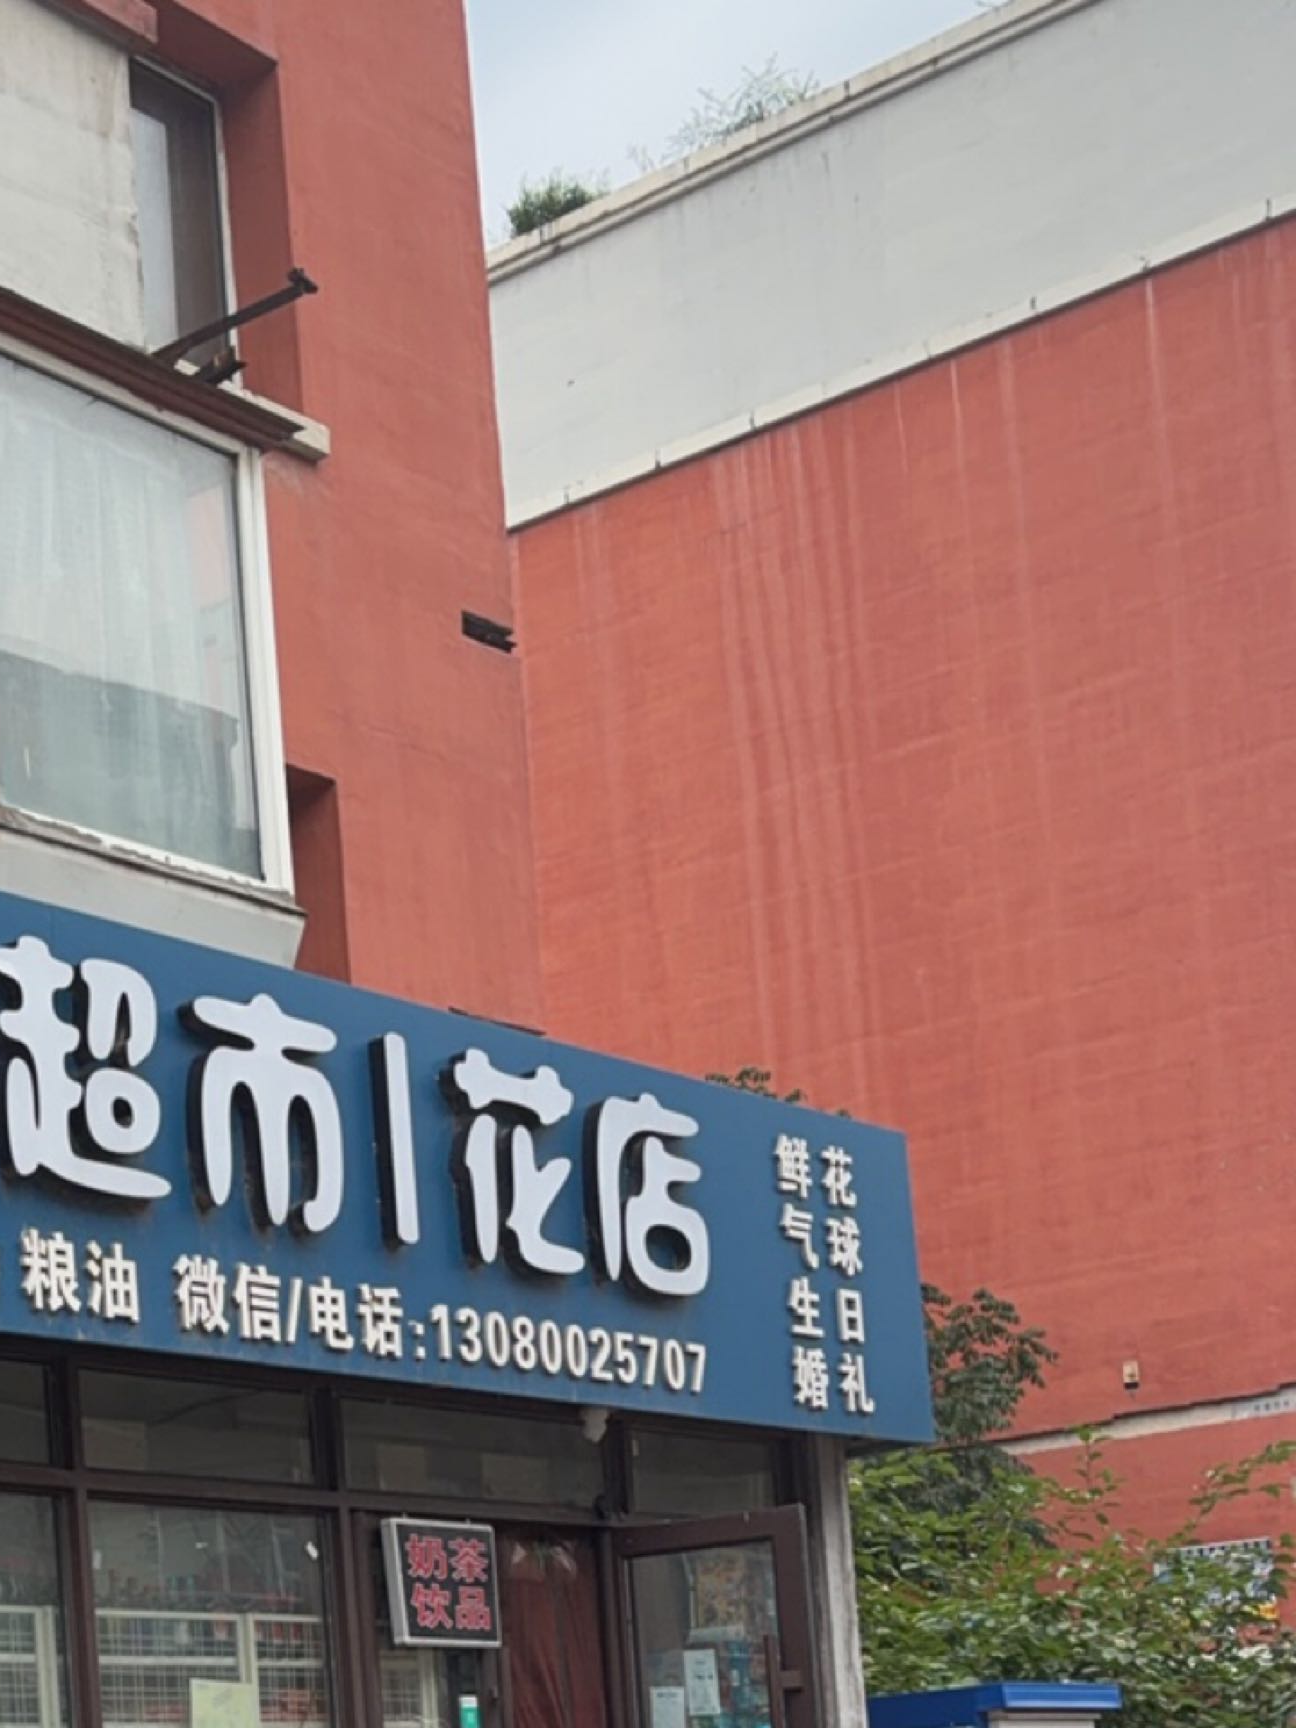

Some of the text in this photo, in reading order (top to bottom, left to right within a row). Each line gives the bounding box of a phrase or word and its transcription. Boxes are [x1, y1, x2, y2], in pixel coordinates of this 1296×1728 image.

[773, 1132, 857, 1208] 鲜花
[779, 1203, 864, 1277] 气球
[20, 1230, 141, 1325] 粮油
[787, 1275, 866, 1344] 生日
[792, 1345, 876, 1415] 婚礼
[405, 1533, 489, 1583] 奶茶
[410, 1583, 492, 1630] 饮品
